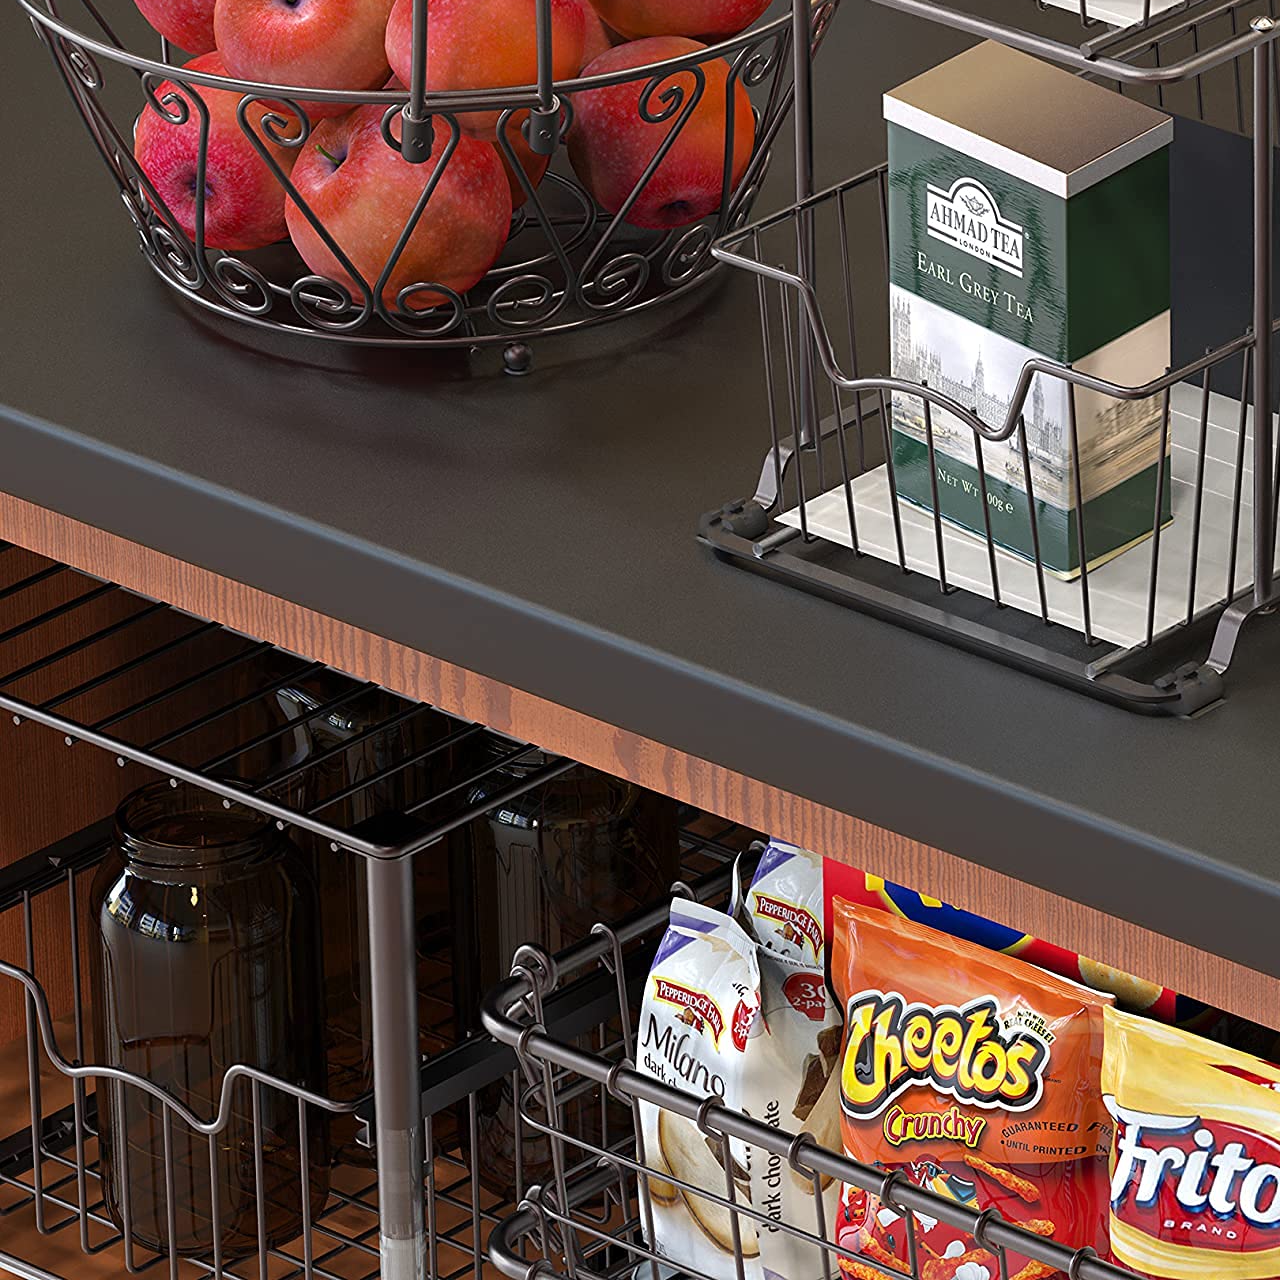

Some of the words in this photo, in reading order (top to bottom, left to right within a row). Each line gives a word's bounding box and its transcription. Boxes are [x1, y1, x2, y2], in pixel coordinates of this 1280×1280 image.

[930, 201, 988, 244] AHMAD
[990, 227, 1020, 260] TEA
[959, 238, 991, 259] LONDON
[917, 251, 954, 285] EARL
[959, 272, 999, 306] GREY
[1003, 291, 1033, 323] TEA
[985, 492, 1004, 512] 00g
[760, 897, 808, 928] PEPPERIDGE
[806, 918, 821, 950] FARM
[660, 982, 708, 1013] PEPPERIDGE
[706, 1003, 721, 1035] FARM
[641, 1013, 725, 1098] Milano
[644, 1053, 666, 1083] dark
[841, 996, 1041, 1105] Cheetos
[885, 1105, 985, 1145] Crunchy
[1002, 1121, 1078, 1138] GUARANTEED
[1086, 1121, 1113, 1140] FRE
[1006, 1139, 1030, 1153] UNTIL
[1032, 1144, 1087, 1156] PRINTED
[761, 1192, 782, 1233] dark
[1163, 1220, 1238, 1240] BRAND
